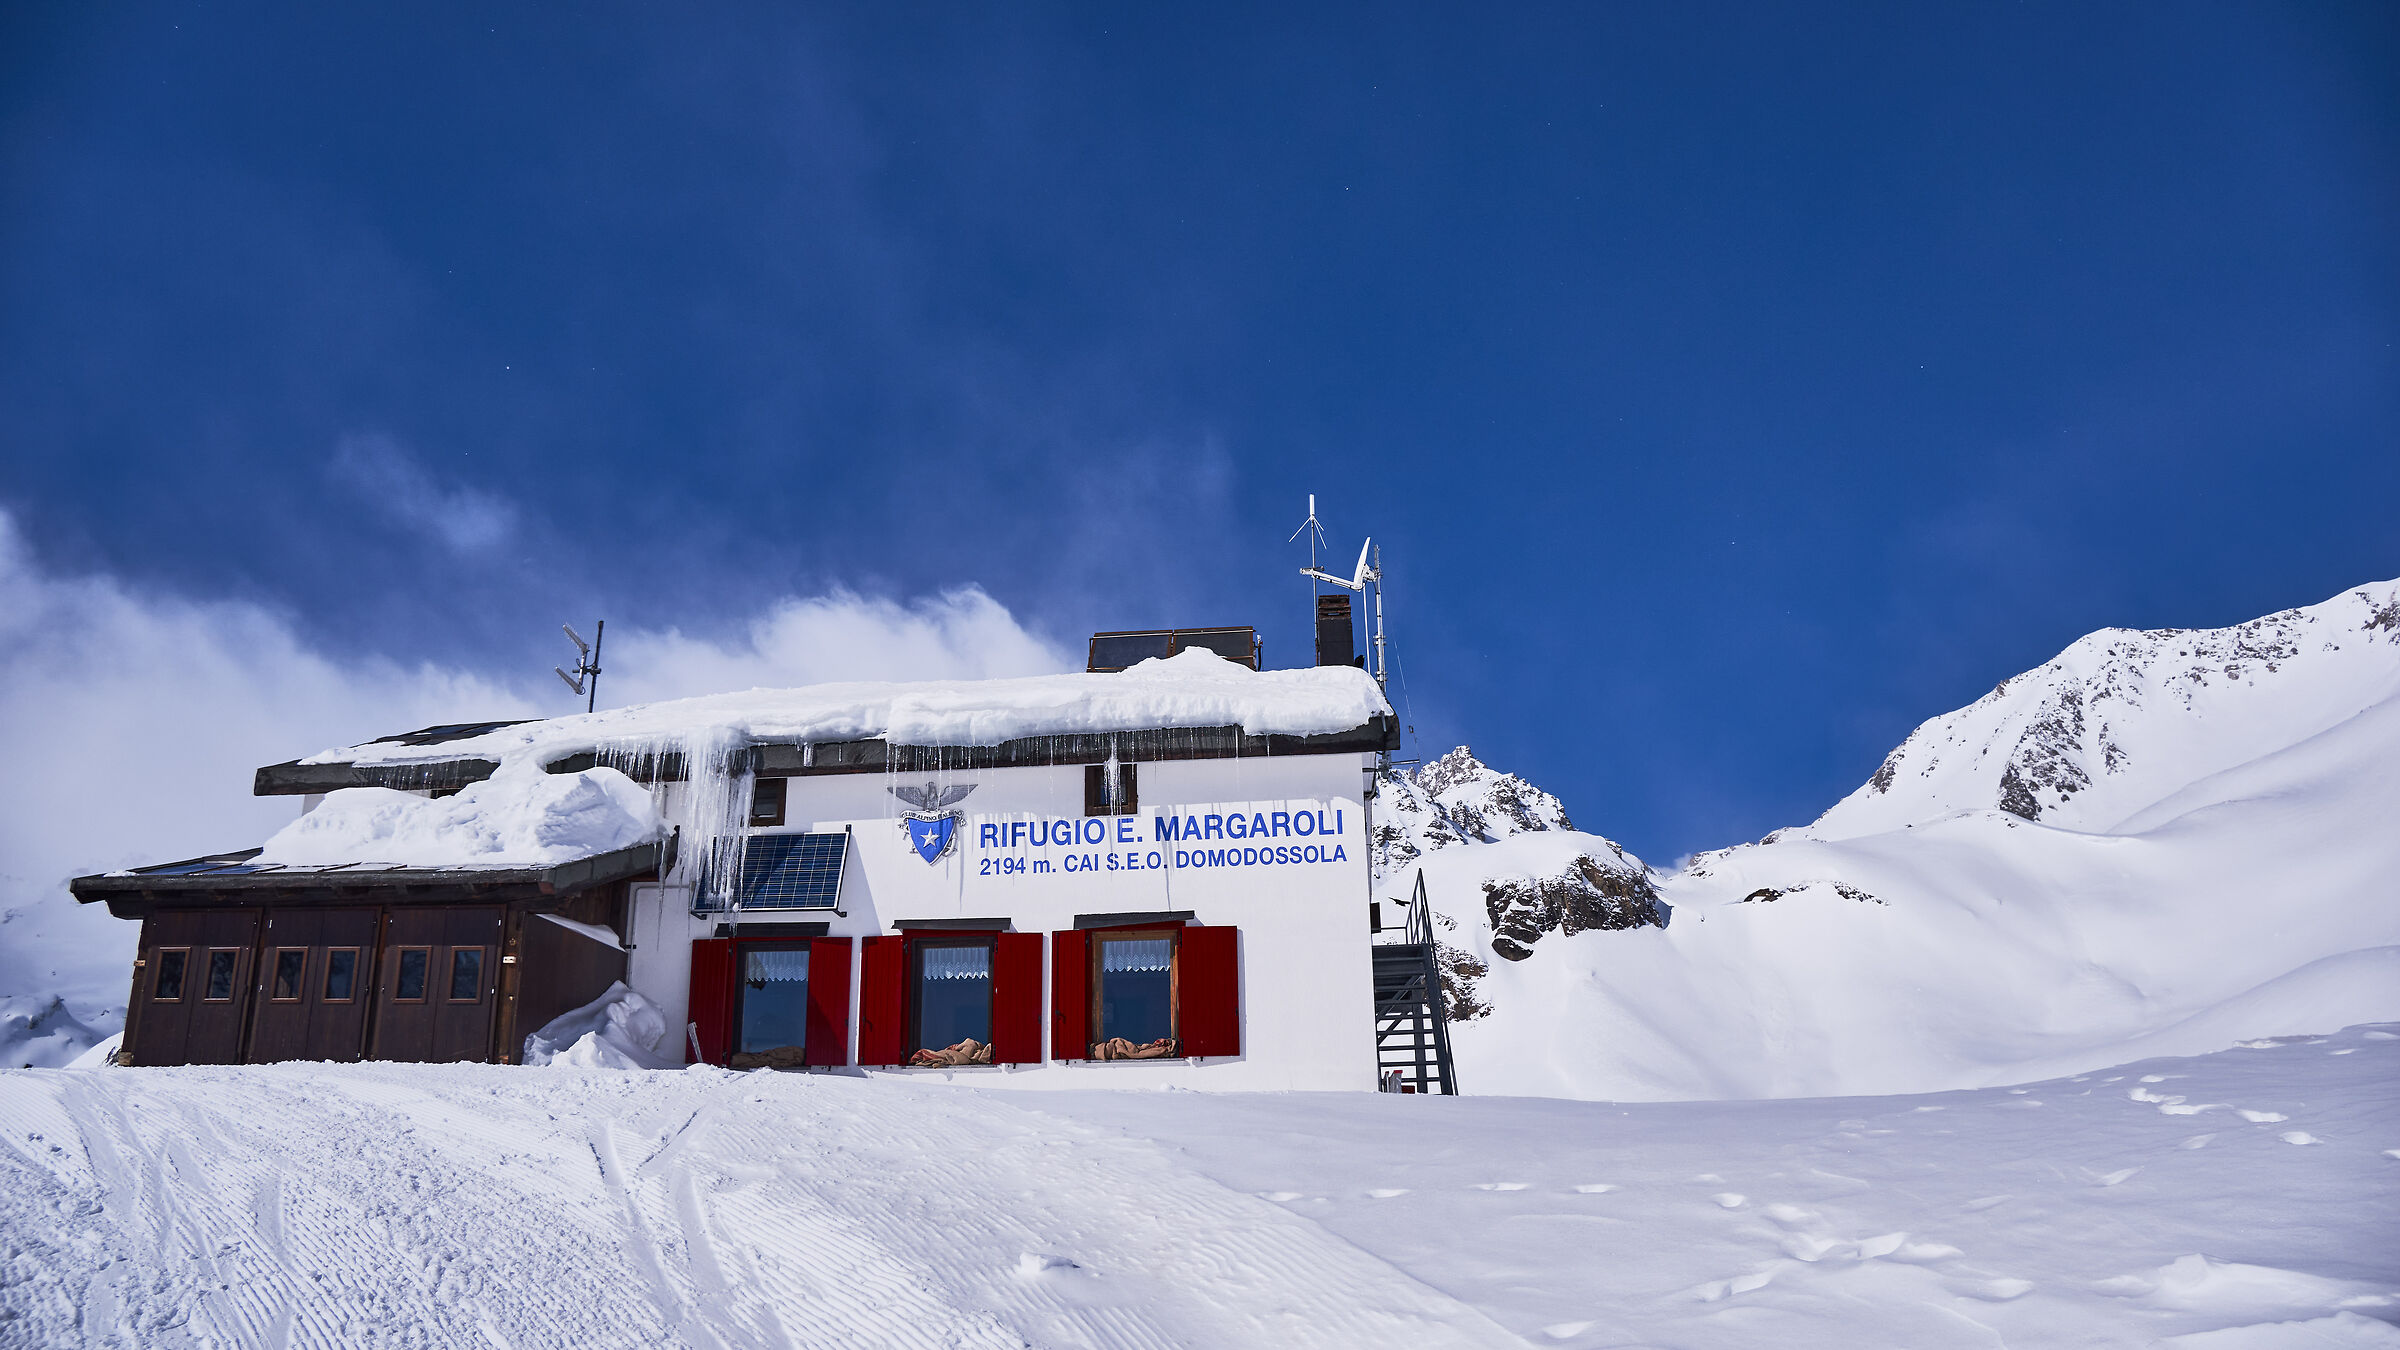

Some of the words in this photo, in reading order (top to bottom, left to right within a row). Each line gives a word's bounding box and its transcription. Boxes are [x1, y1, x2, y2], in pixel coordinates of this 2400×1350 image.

[980, 817, 1106, 849] RIFUGIO
[1117, 817, 1143, 844] E.
[1155, 809, 1343, 842] MARGAROLI
[980, 857, 1026, 876] 2194
[1033, 860, 1057, 874] m.
[1063, 853, 1099, 873] CAI
[1106, 851, 1169, 871] S.E.O.
[1175, 844, 1347, 869] DOMODOSSOLA
